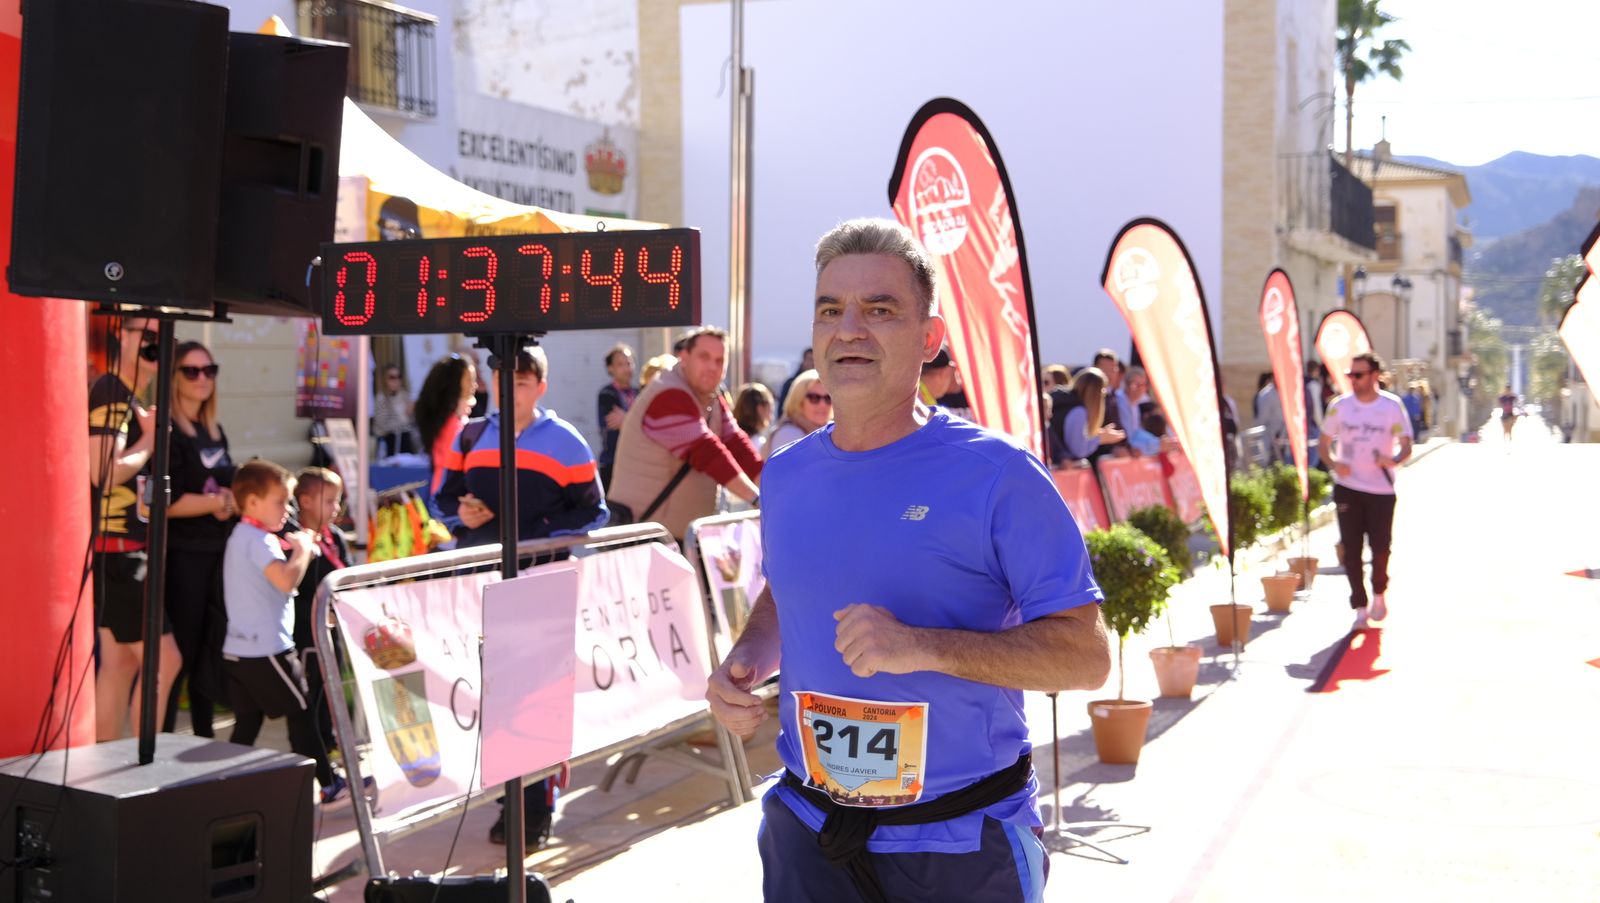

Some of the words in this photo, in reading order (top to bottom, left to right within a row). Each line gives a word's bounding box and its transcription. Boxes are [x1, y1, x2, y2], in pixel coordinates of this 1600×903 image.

[457, 129, 577, 176] EXCELENTÍSIMO
[334, 243, 683, 327] 01:37:44
[649, 588, 674, 615] DE
[814, 702, 847, 718] PÓLVORA
[863, 706, 897, 716] CANTORIA
[812, 719, 898, 761] 214
[850, 767, 878, 775] JAVIER
